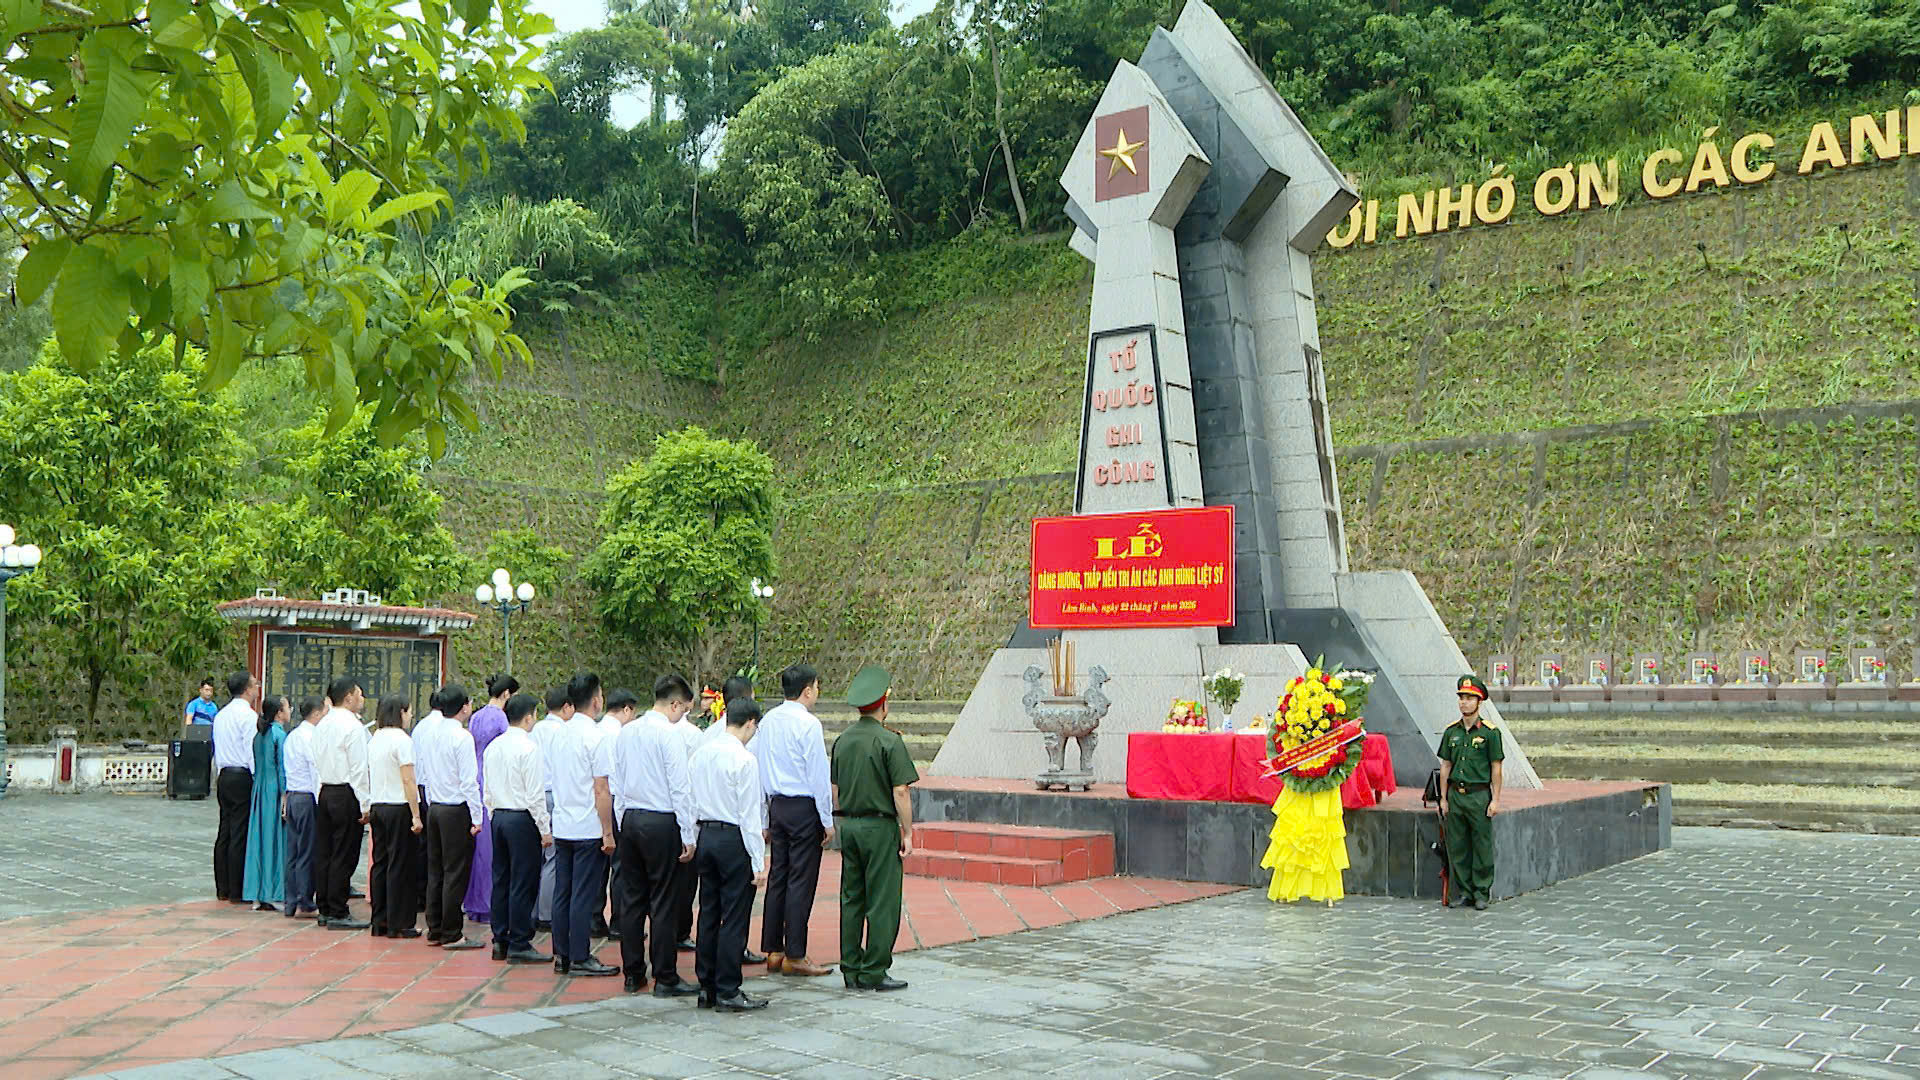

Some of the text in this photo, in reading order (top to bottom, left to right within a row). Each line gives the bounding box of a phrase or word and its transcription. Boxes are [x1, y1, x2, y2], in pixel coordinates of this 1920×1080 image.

[1396, 164, 1516, 239] NHỚ
[1533, 160, 1620, 216] ƠN
[1642, 126, 1776, 198] CÁC
[1093, 378, 1155, 412] QUỐC
[1105, 424, 1143, 448] GHI
[1093, 458, 1156, 486] CÔNG
[1094, 522, 1163, 560] LỄ
[1118, 570, 1129, 587] TRI
[1143, 565, 1157, 587] CÁC
[1159, 567, 1174, 586] ANH
[1197, 562, 1212, 588] LIỆT
[1101, 602, 1119, 615] ngày
[1129, 601, 1152, 613] tháng
[1161, 601, 1178, 611] năm
